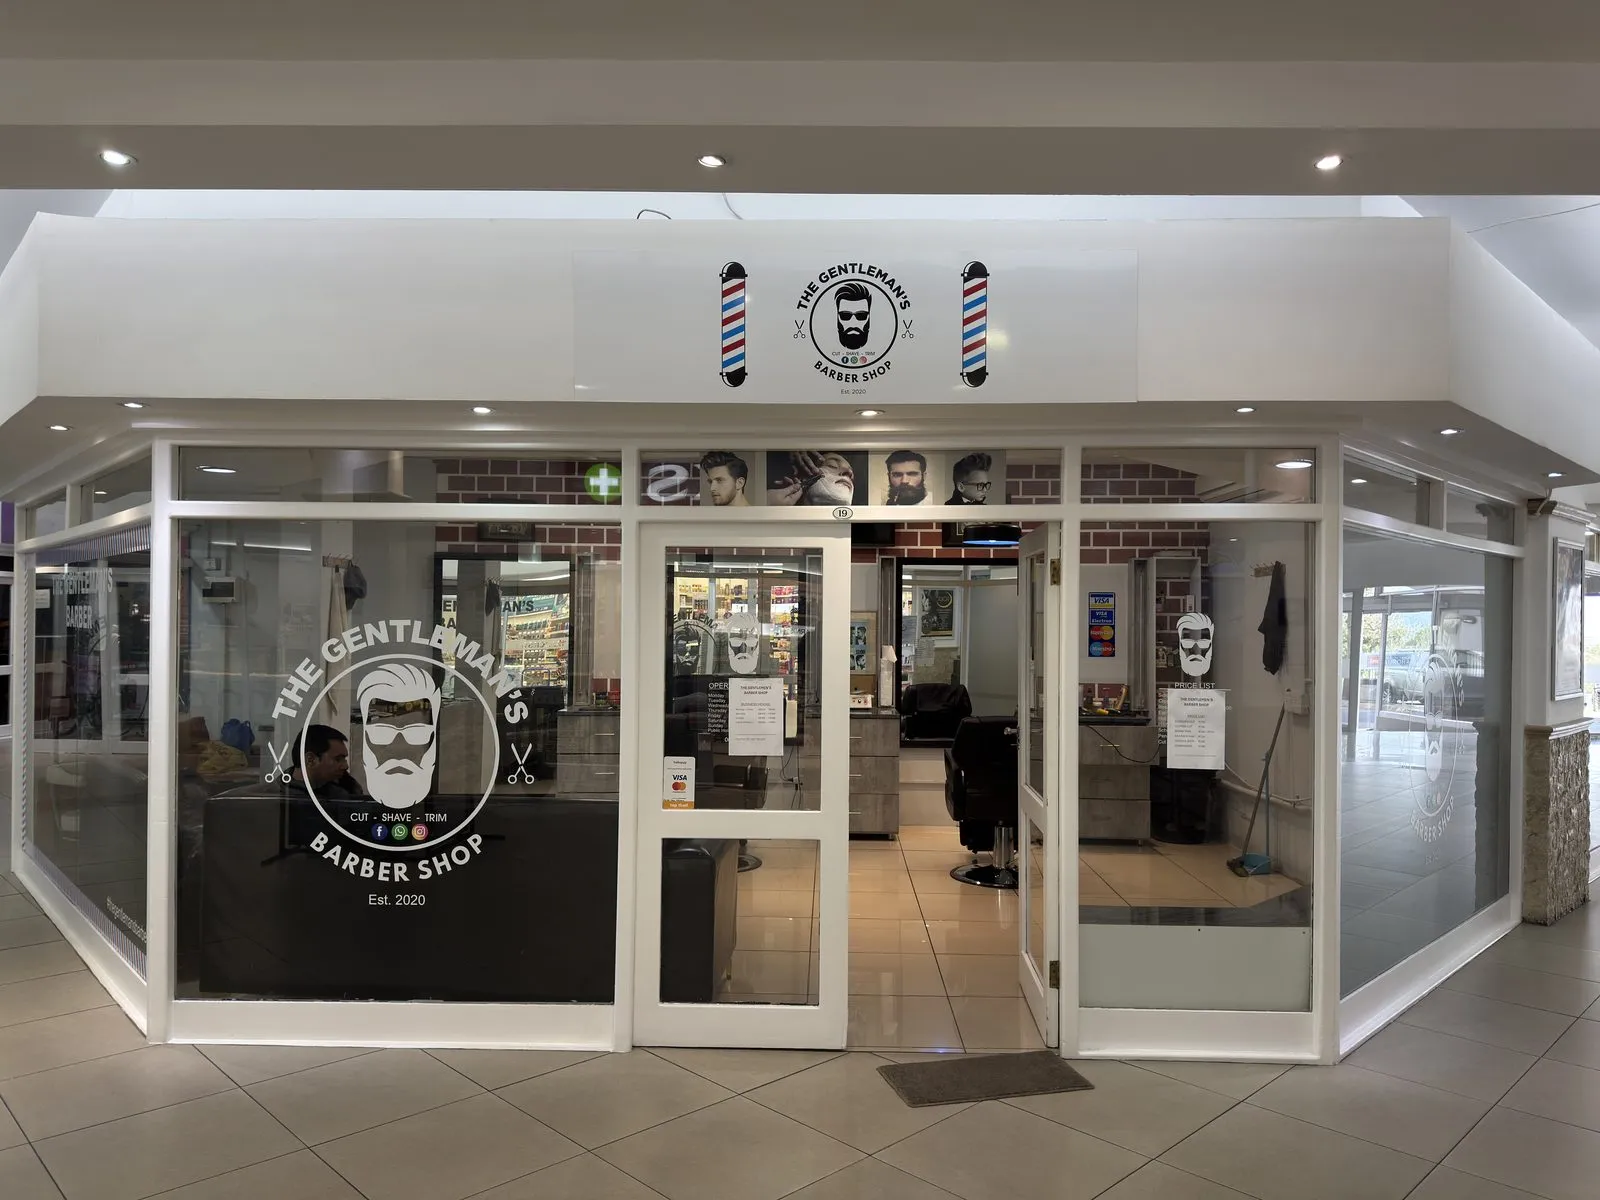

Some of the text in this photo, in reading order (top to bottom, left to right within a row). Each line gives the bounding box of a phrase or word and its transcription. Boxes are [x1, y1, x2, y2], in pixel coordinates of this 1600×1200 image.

[796, 262, 911, 311] THE GENTLEMAN'S
[814, 360, 892, 383] BARBER SHOP
[838, 509, 848, 517] 19
[271, 619, 529, 724] THE GENTLEMAN'S
[350, 812, 369, 823] CUT
[381, 812, 412, 823] SHAVE
[424, 812, 447, 823] TRIM
[309, 831, 484, 882] BARBER SHOP
[368, 893, 426, 906] Est. 2020
